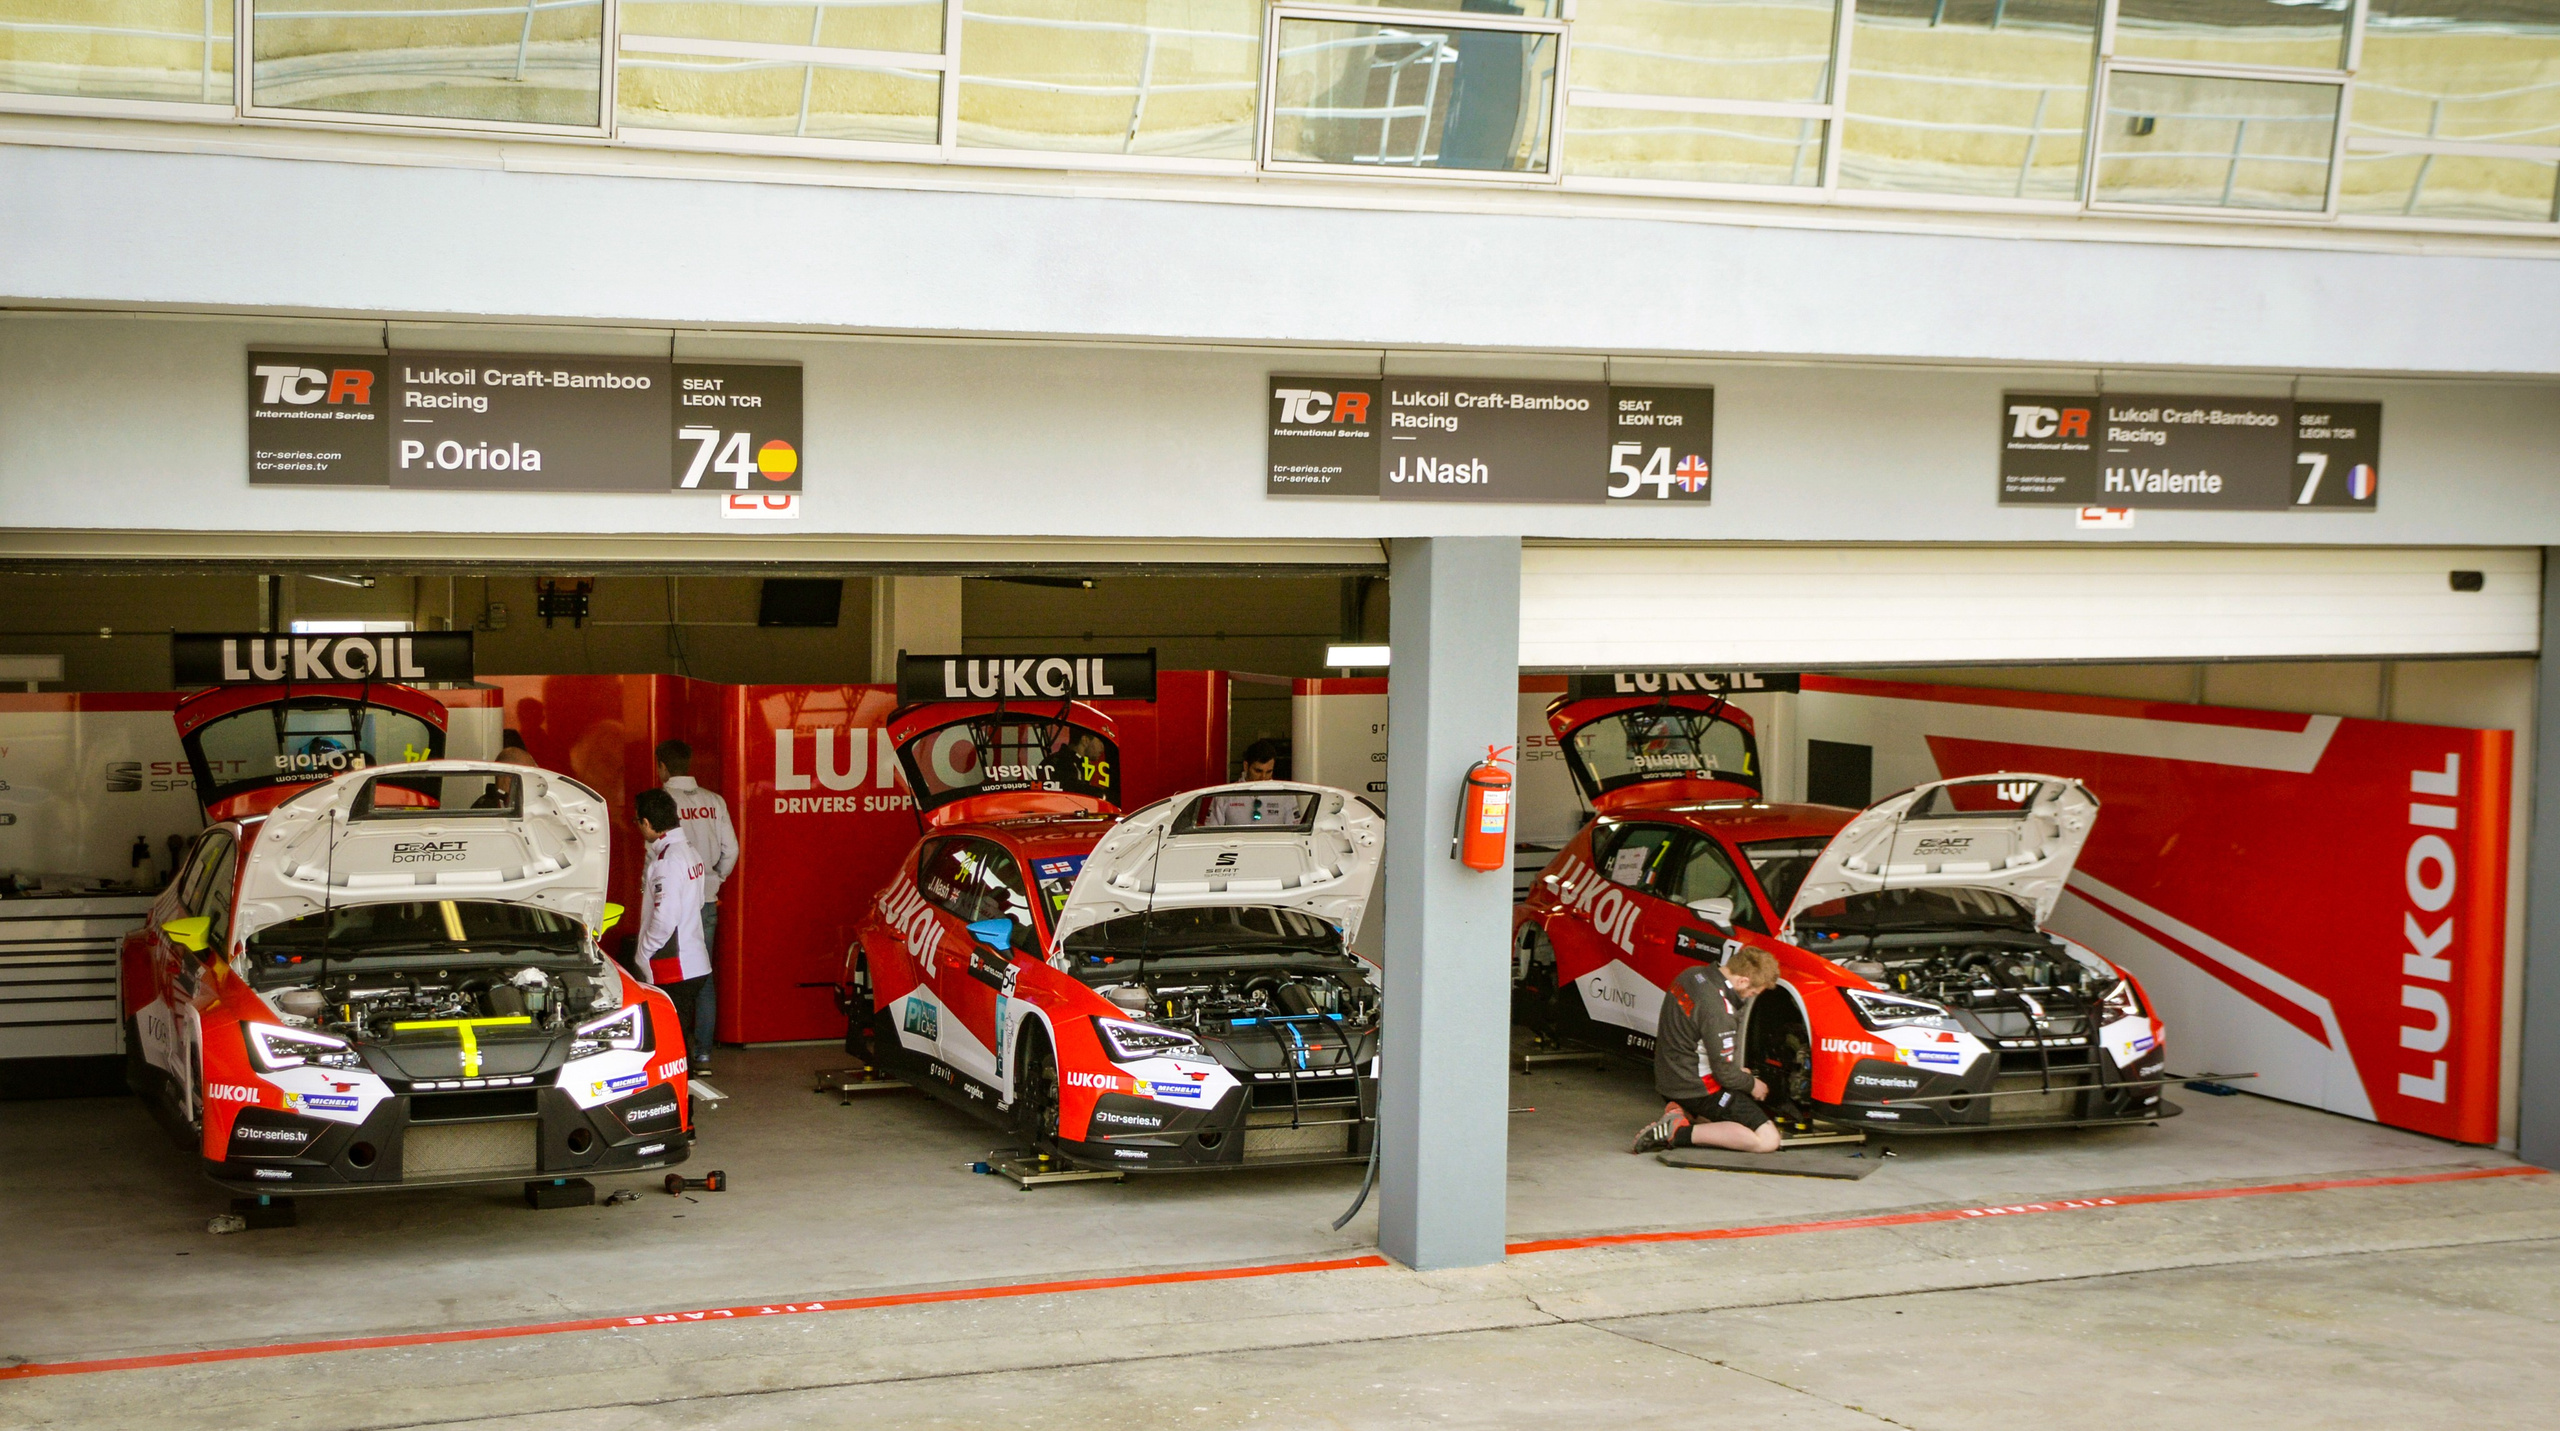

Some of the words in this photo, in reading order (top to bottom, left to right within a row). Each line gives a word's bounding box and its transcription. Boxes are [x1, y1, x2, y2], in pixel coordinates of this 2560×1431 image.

[255, 365, 374, 404] TCR
[405, 367, 476, 386] Lukoil
[483, 369, 651, 390] Craft-Bamboo
[683, 378, 723, 391] SEAT
[405, 392, 489, 413] Racing
[683, 395, 727, 408] LEON
[730, 396, 762, 408] TCR
[1274, 389, 1370, 424] TCR
[1391, 391, 1449, 408] Lukoil
[1454, 392, 1590, 412] Craft-Bamboo
[1618, 400, 1652, 411] SEAT
[256, 410, 332, 421] International
[335, 411, 375, 421] Series
[1391, 413, 1458, 432] Racing
[1618, 414, 1653, 426] LEON
[1657, 415, 1683, 426] TCR
[2008, 405, 2091, 438] TCR
[2108, 408, 2159, 424] Lukoil
[2162, 409, 2279, 427] Craft-Bamboo
[2300, 415, 2330, 426] SEAT
[1274, 428, 1336, 438] International
[1338, 429, 1370, 438] Series
[2108, 428, 2166, 445] Racing
[2300, 429, 2331, 439] LEON
[2333, 430, 2356, 440] TCR
[2007, 442, 2062, 451] International
[2063, 443, 2090, 451] Series
[256, 449, 342, 462] tcr-series.com
[401, 439, 542, 472] P.Oriola
[678, 429, 758, 490] 74
[256, 461, 328, 472] tcr-series.tv
[1273, 464, 1342, 475] tcr-series.com
[1390, 456, 1488, 485] J.Nash
[1608, 444, 1676, 499] 54
[1273, 474, 1331, 484] tcr-series.tv
[2006, 475, 2065, 484] tcr-series.com
[2104, 468, 2222, 494] H.Valente
[2297, 453, 2328, 505] 7
[223, 637, 425, 681] LUKOIL
[945, 658, 1114, 698] LUKOIL
[1526, 734, 1596, 748] SET
[1634, 753, 1718, 769] H.Valente
[985, 765, 1055, 781] J.Nash
[1082, 756, 1110, 787] 54
[1642, 769, 1715, 780] TCR-series.com
[982, 781, 1063, 792] TCR-series.com
[775, 796, 856, 814] DRIVERS
[394, 841, 468, 854] CRAFT
[392, 853, 466, 863] bamboo
[927, 876, 950, 899] J.Nash
[1544, 854, 1641, 956] LUKOIL
[879, 871, 945, 979] LUKOIL
[2397, 752, 2461, 1104] LUKOIL
[1002, 968, 1016, 992] 54
[1627, 1034, 1655, 1051] gravit
[1821, 1038, 1875, 1055] LUKOIL
[612, 1075, 647, 1088] MICHELIN
[930, 1063, 955, 1085] gravity
[1067, 1071, 1119, 1090] LUKOIL
[1157, 1085, 1201, 1094] MICHELIN
[1865, 1076, 1918, 1089] tcr-series.tv
[209, 1083, 260, 1103] LUKOIL
[310, 1098, 358, 1107] MICHELIN
[638, 1103, 677, 1120] tcr-series.tv
[1108, 1113, 1161, 1127] tcr-series.tv
[249, 1127, 308, 1141] tcr-series.tv
[1962, 1204, 2048, 1217] LANE
[2063, 1198, 2117, 1208] PIT
[760, 1303, 825, 1314] PIT
[625, 1309, 734, 1325] LANE
